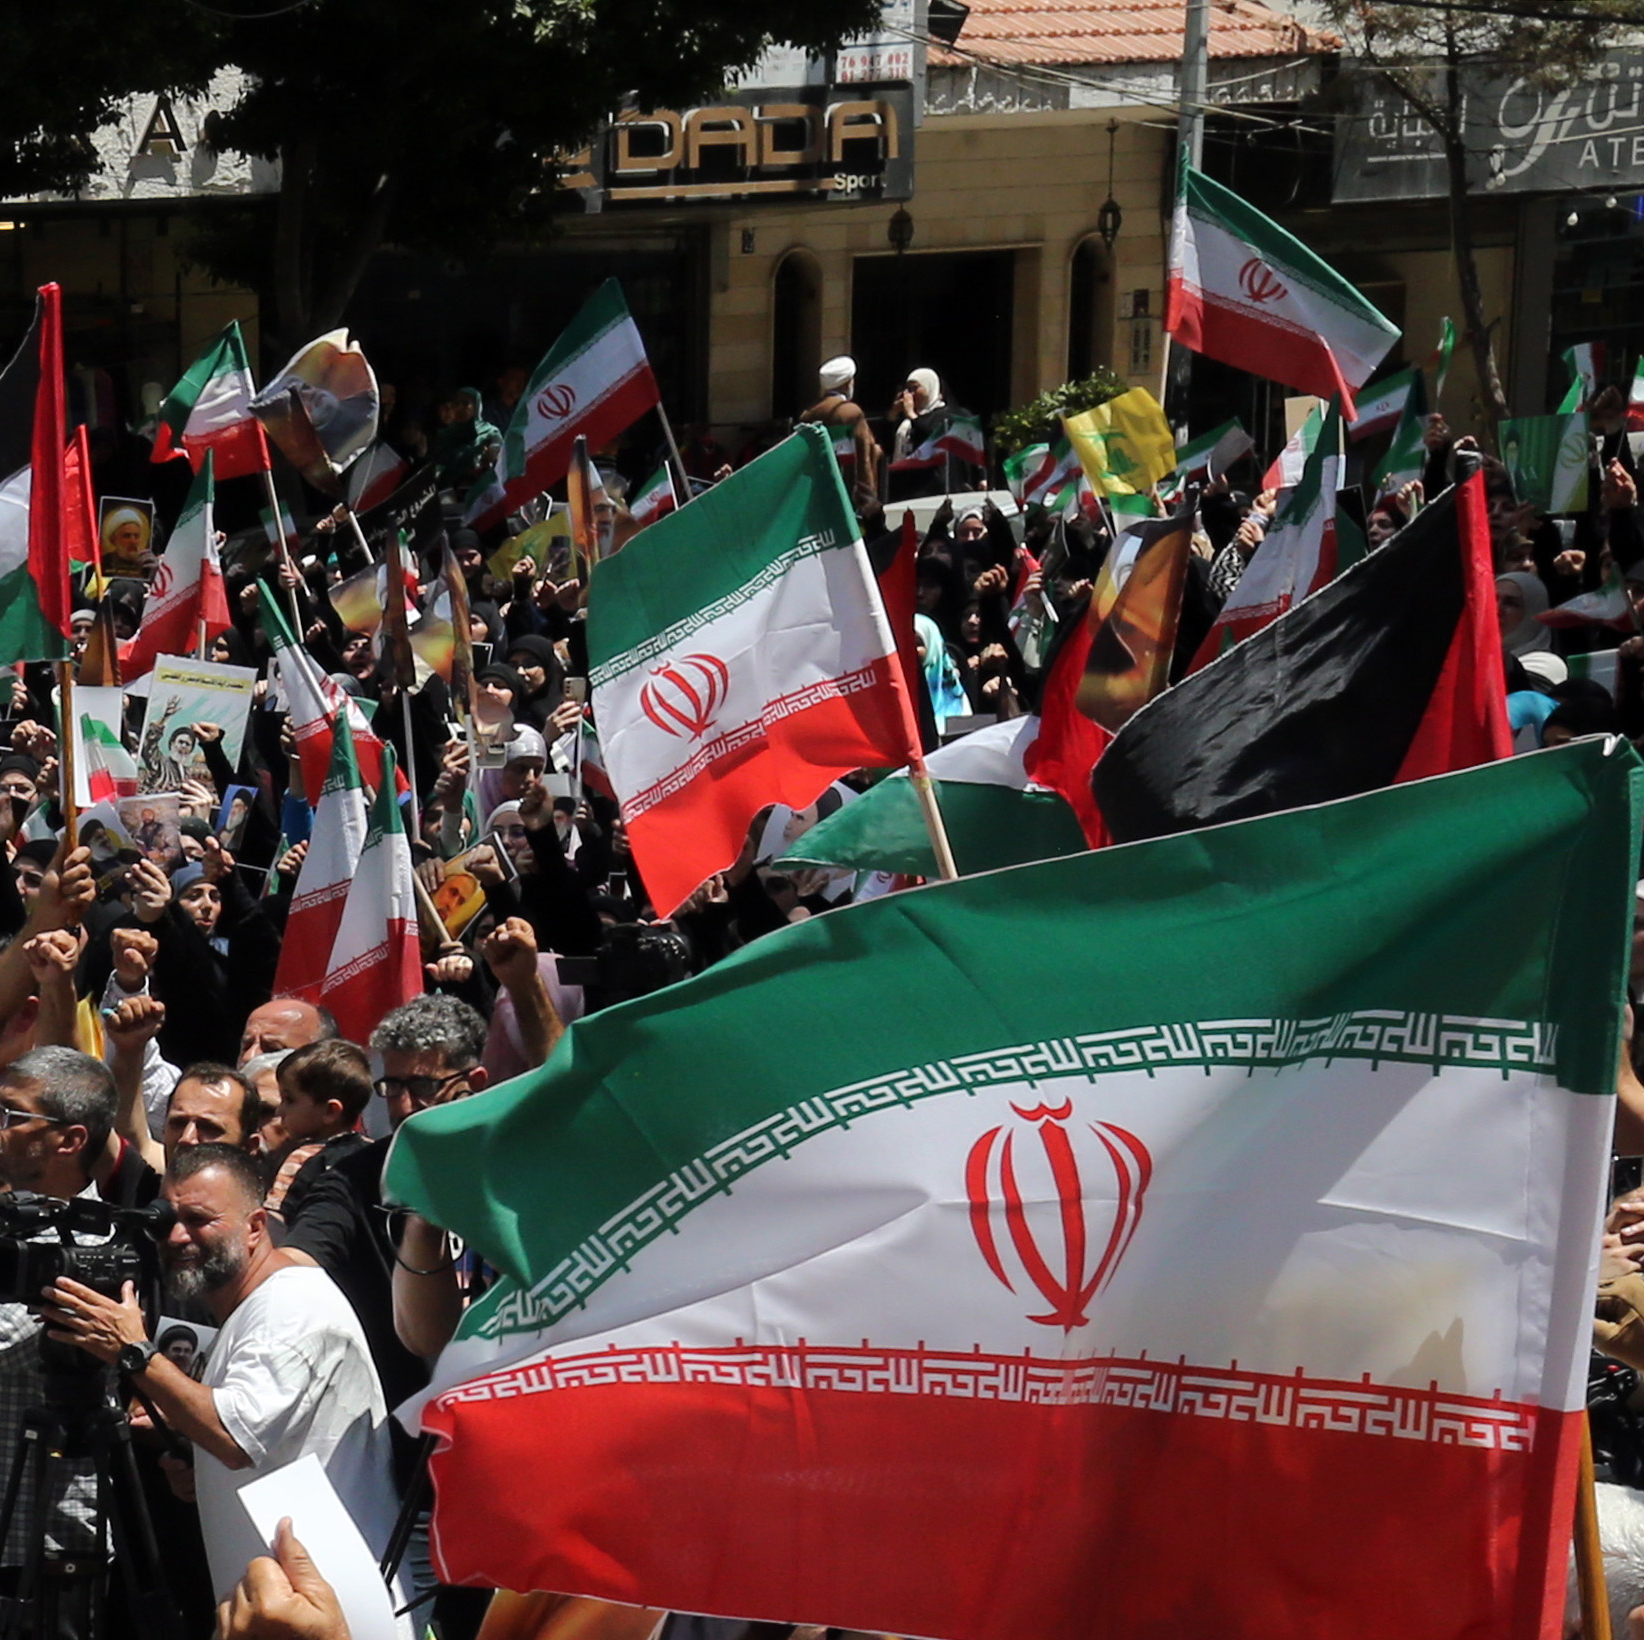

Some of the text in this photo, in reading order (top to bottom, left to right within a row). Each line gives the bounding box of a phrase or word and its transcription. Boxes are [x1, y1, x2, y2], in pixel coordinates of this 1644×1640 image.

[842, 52, 908, 68] 76 947 002
[842, 66, 908, 83] 01 277 318
[608, 101, 900, 174] DADA
[833, 171, 888, 196] Sport
